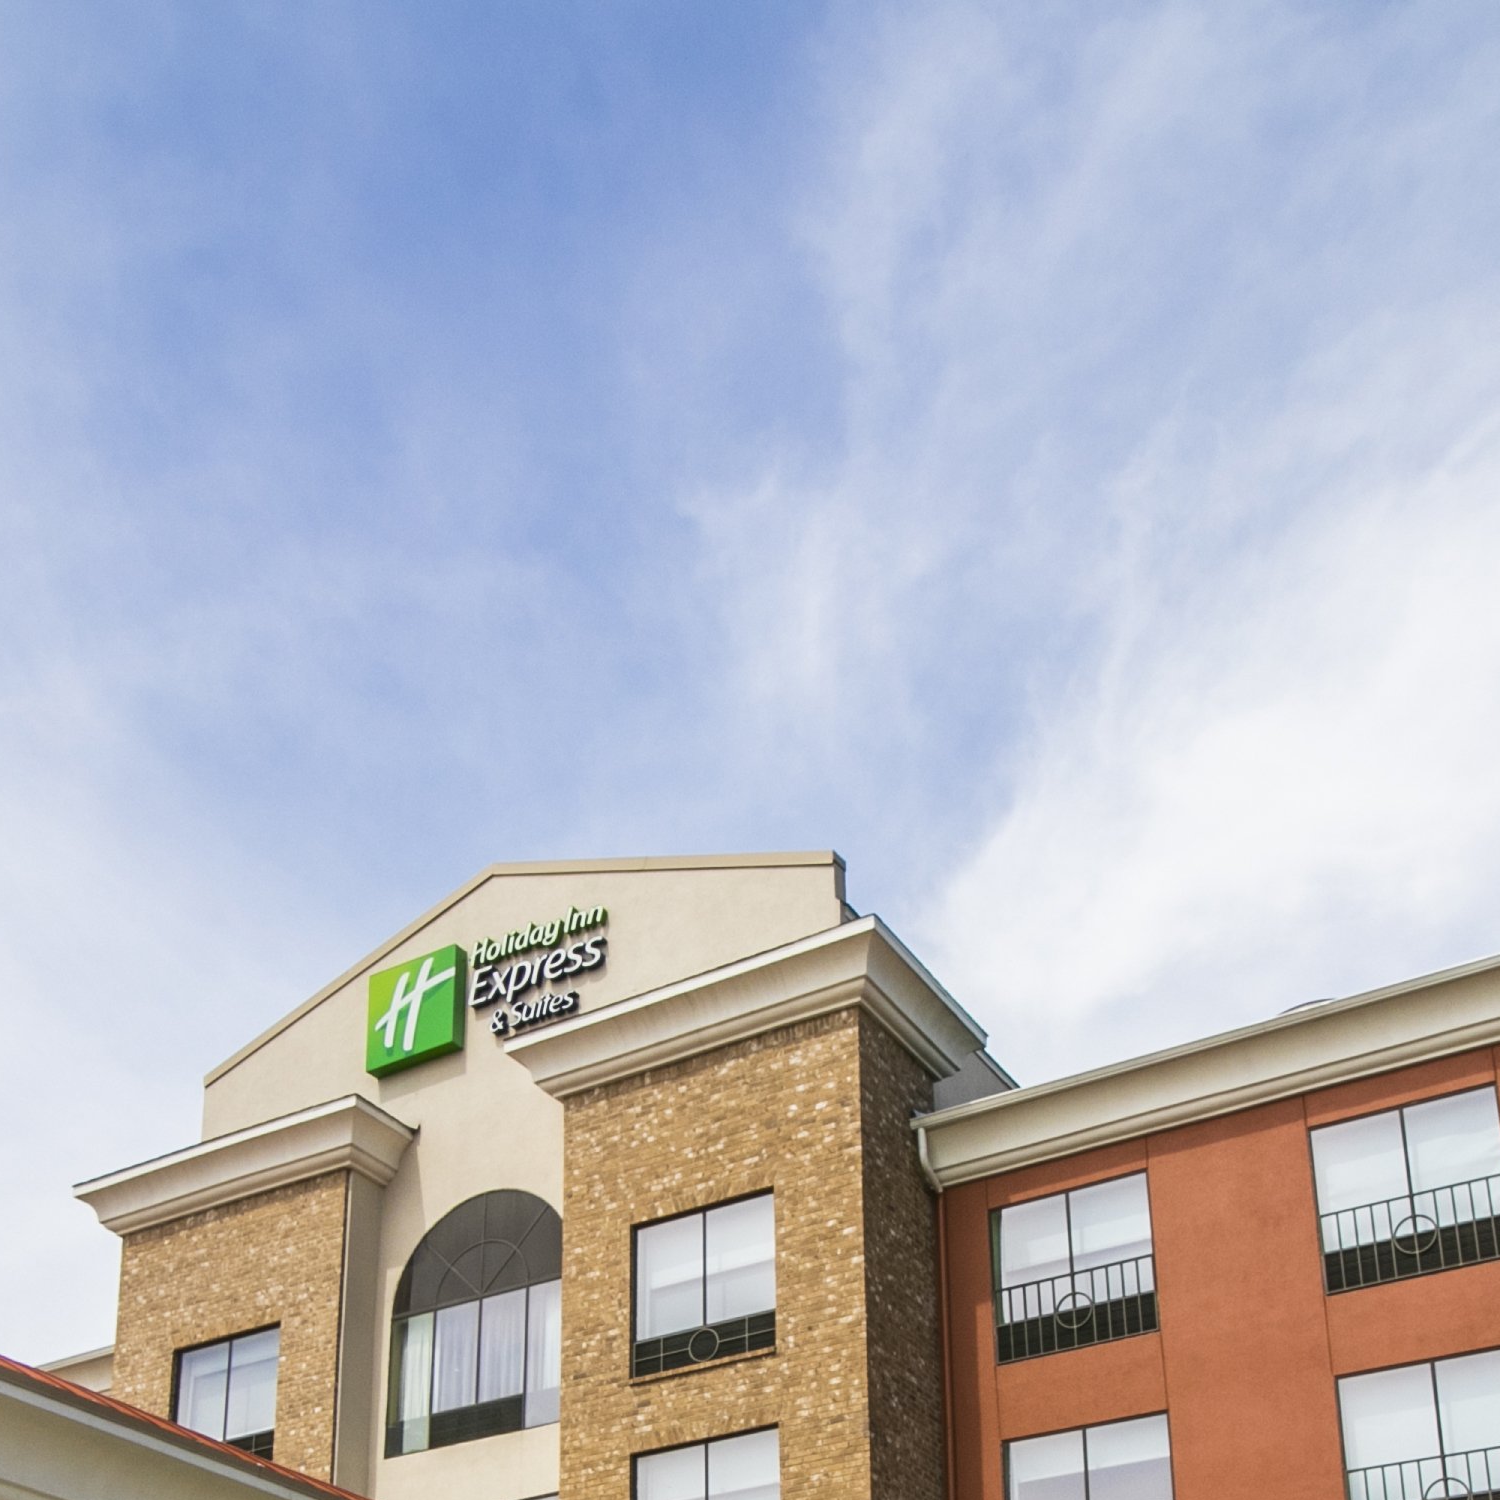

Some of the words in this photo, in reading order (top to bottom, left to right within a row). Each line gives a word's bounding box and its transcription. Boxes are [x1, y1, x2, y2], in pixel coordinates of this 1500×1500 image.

[469, 919, 564, 968] Holiday
[564, 904, 606, 934] Inn
[468, 936, 605, 1006] Express
[489, 1009, 506, 1033] &
[509, 990, 577, 1027] Suites
